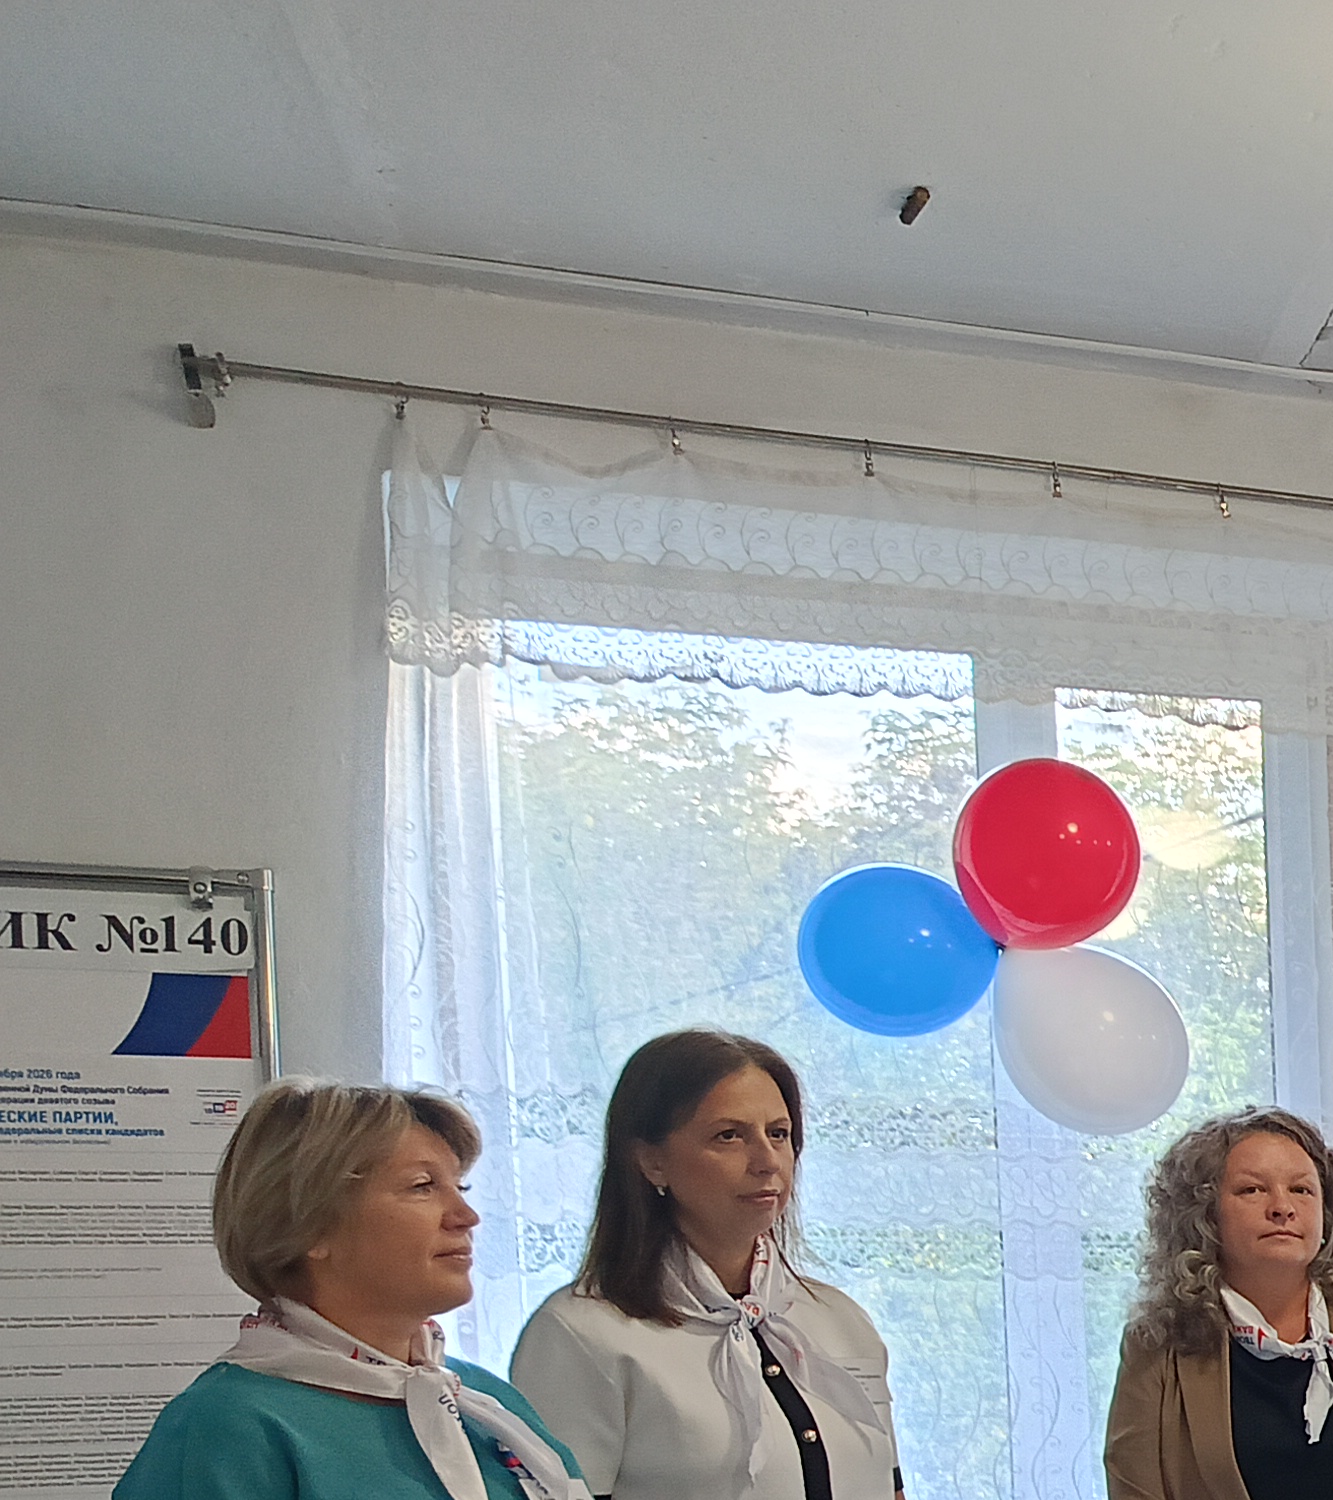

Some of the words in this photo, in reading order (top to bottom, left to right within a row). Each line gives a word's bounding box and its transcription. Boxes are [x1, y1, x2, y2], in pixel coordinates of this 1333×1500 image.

[95, 914, 249, 956] №140
[26, 1069, 52, 1079] 2026
[56, 1071, 81, 1080] года
